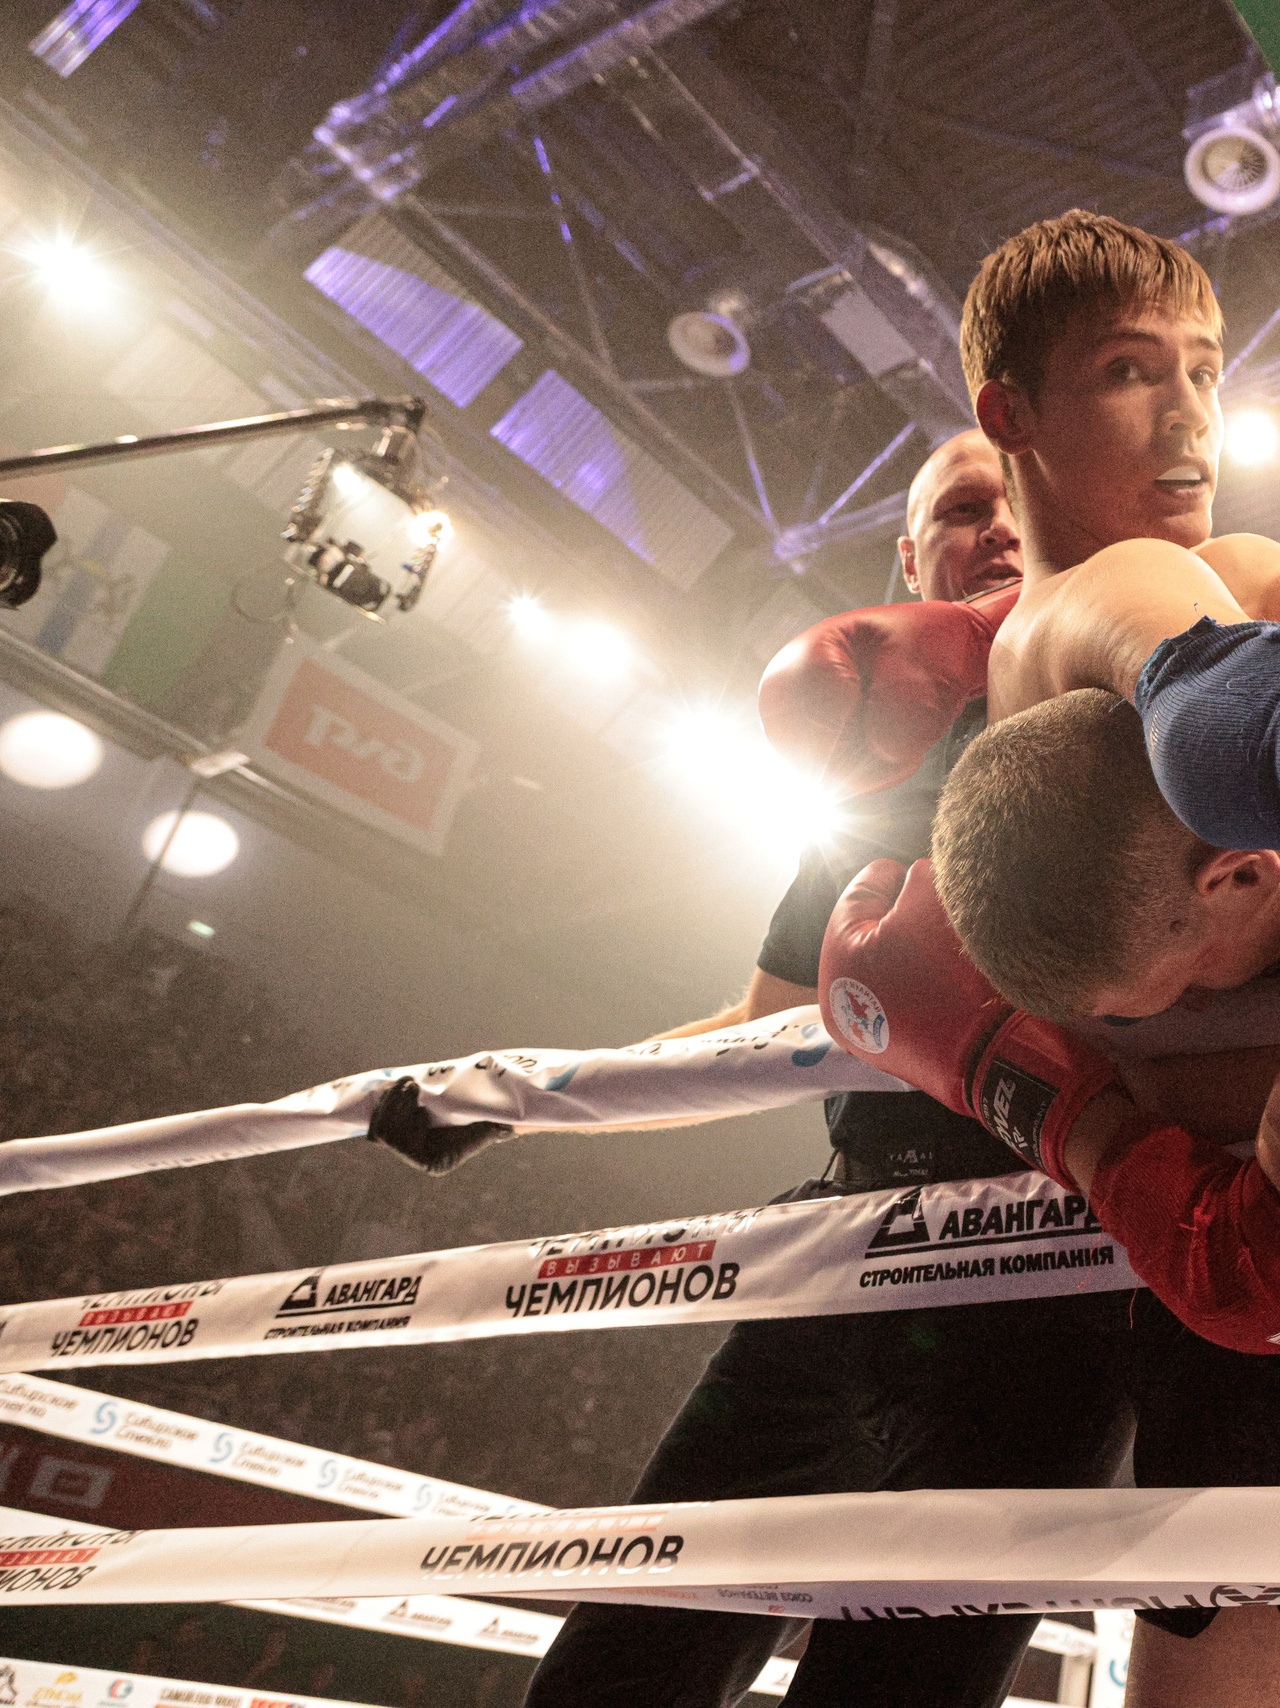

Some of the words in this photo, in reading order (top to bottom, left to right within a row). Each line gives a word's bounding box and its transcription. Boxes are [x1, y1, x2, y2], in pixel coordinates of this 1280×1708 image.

[546, 1242, 708, 1276] ВЫЗЫВАЮТ
[859, 1257, 995, 1288] СТРОИТЕЛЬНАЯ
[1000, 1245, 1114, 1275] КОМПАНИЯ
[322, 1275, 423, 1307] АВАНГАРД
[505, 1262, 741, 1318] ЧЕМПИОНОВ
[51, 1318, 199, 1357] ЧЕМПИОНОВ
[420, 1535, 685, 1580] ЧЕМПИОНОВ
